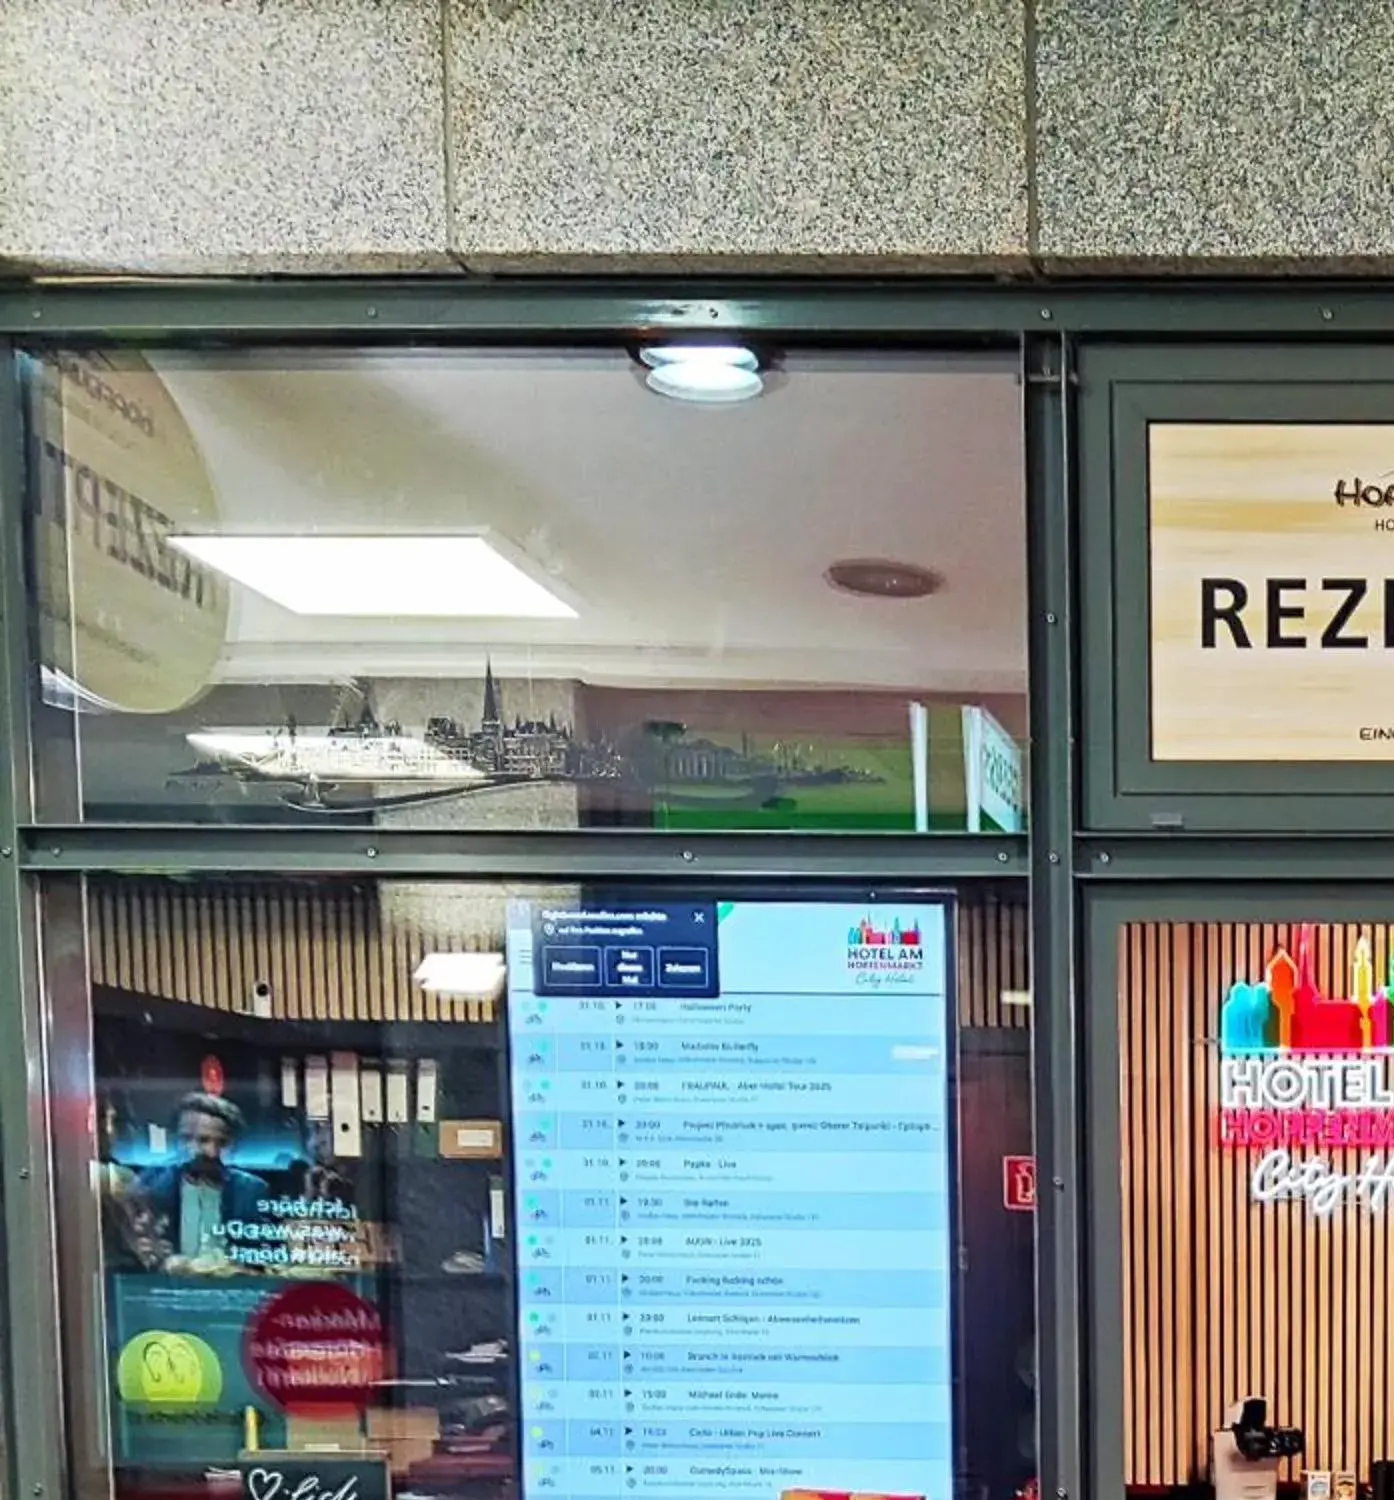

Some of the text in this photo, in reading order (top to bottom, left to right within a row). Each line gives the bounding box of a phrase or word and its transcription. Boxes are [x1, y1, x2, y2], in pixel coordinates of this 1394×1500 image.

[847, 948, 923, 960] HOTEL AM
[1221, 1059, 1393, 1110] HOTEL
[1251, 1152, 1347, 1215] City
